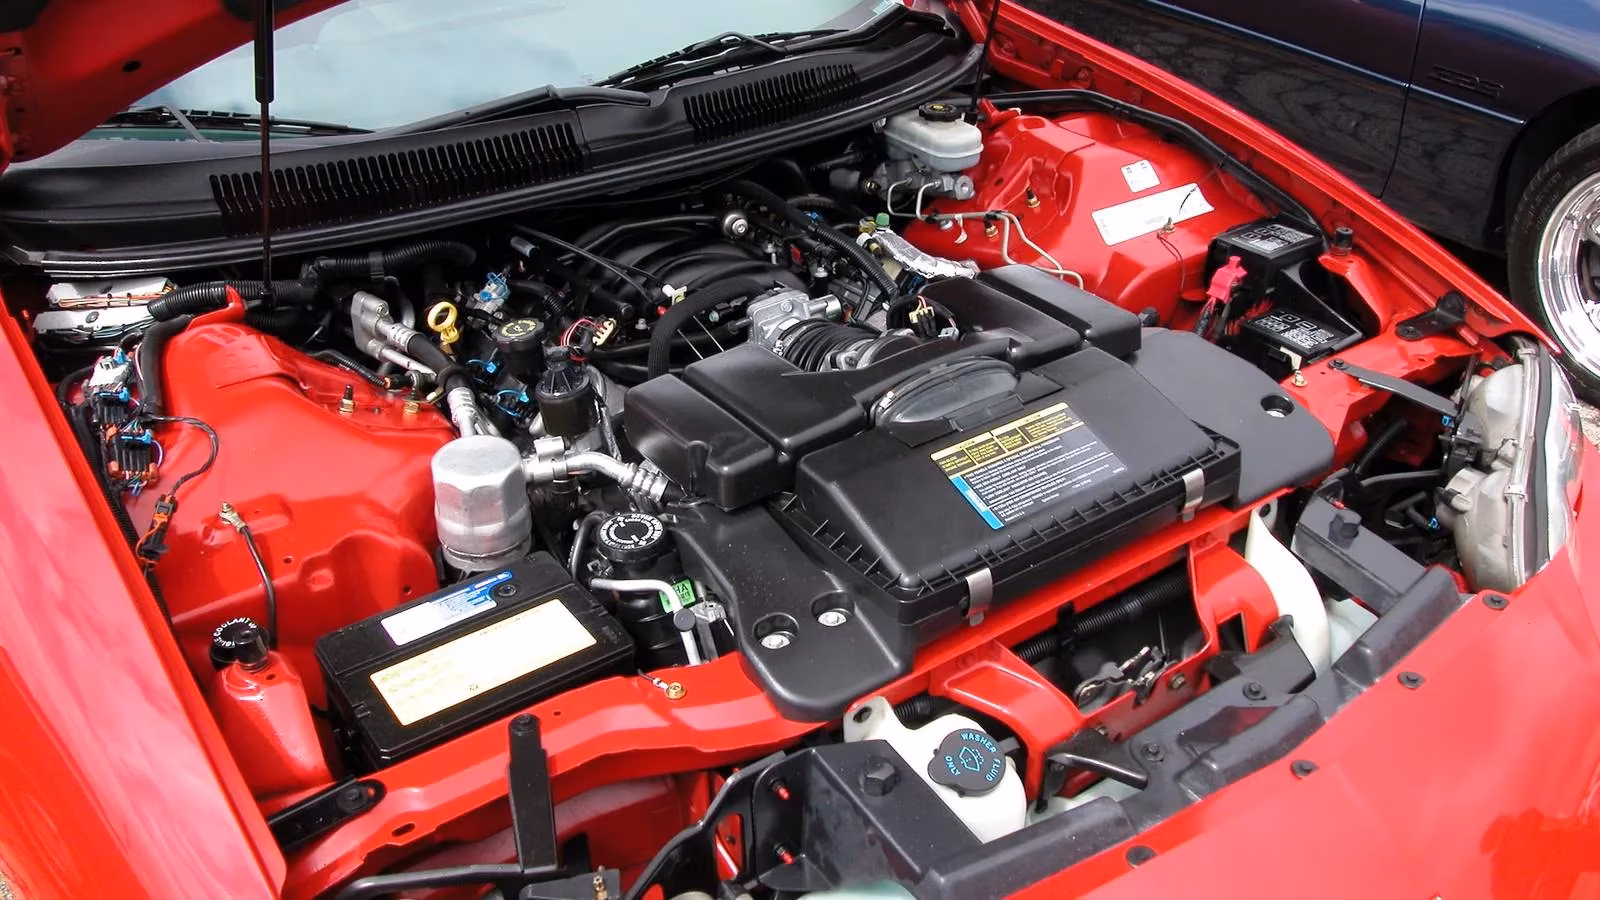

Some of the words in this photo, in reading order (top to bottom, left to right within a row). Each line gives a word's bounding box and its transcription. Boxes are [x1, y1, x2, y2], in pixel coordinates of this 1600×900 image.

[213, 617, 250, 637] COOLANT
[961, 732, 997, 753] WASHER
[945, 755, 961, 776] ONLY
[985, 758, 1001, 782] FLUID
